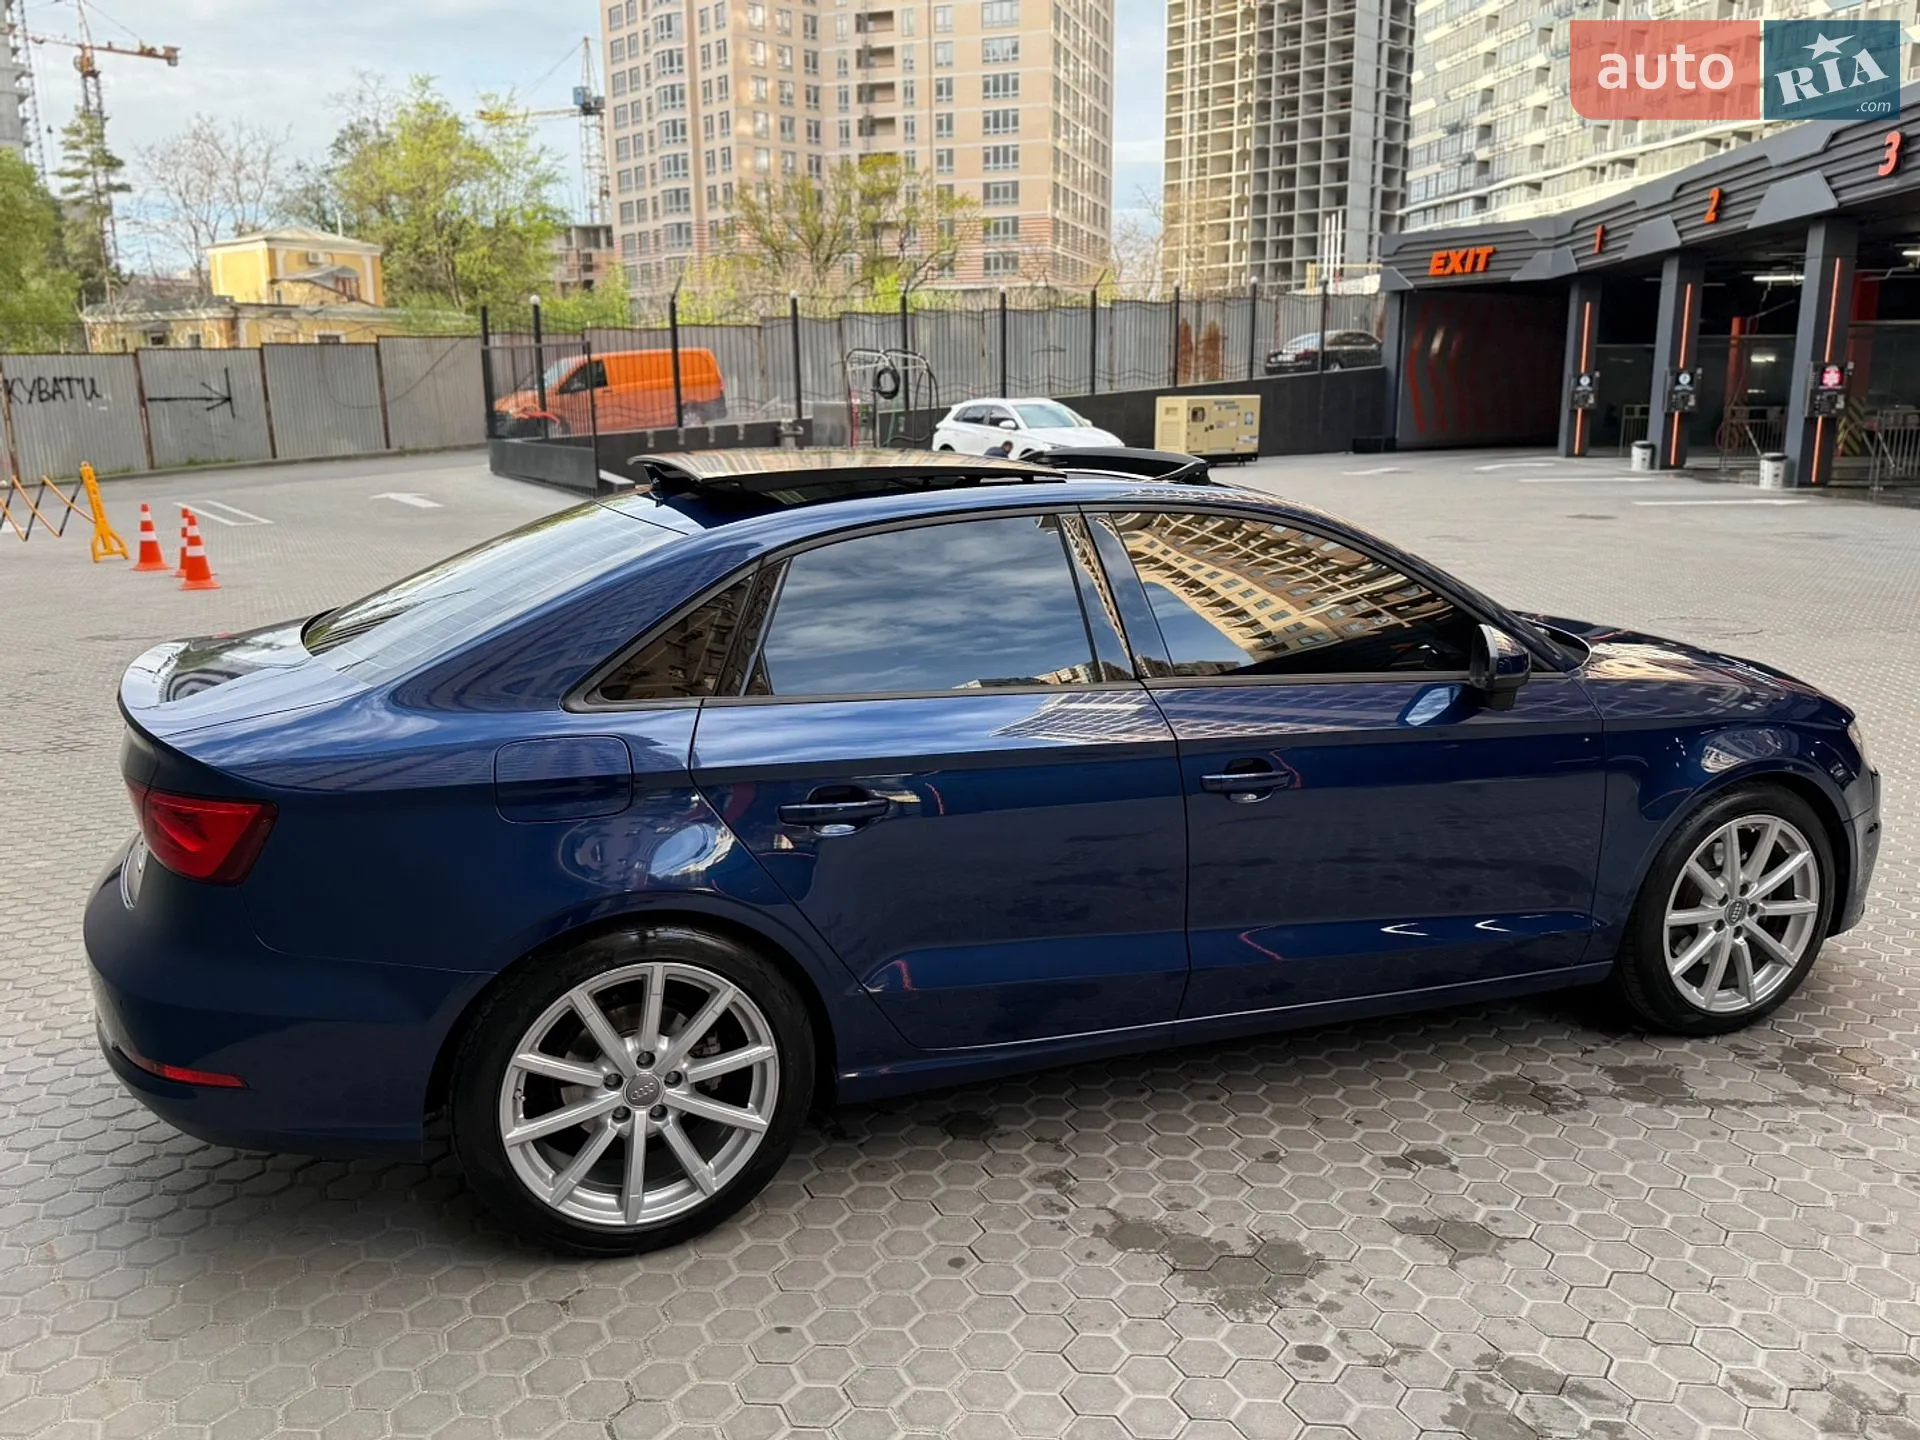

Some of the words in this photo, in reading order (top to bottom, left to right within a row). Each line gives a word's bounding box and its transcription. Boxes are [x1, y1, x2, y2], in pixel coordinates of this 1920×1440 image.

[1877, 130, 1902, 177] 3
[1704, 187, 1722, 224] 2
[1592, 225, 1606, 254] 1
[1428, 246, 1495, 276] EXIT
